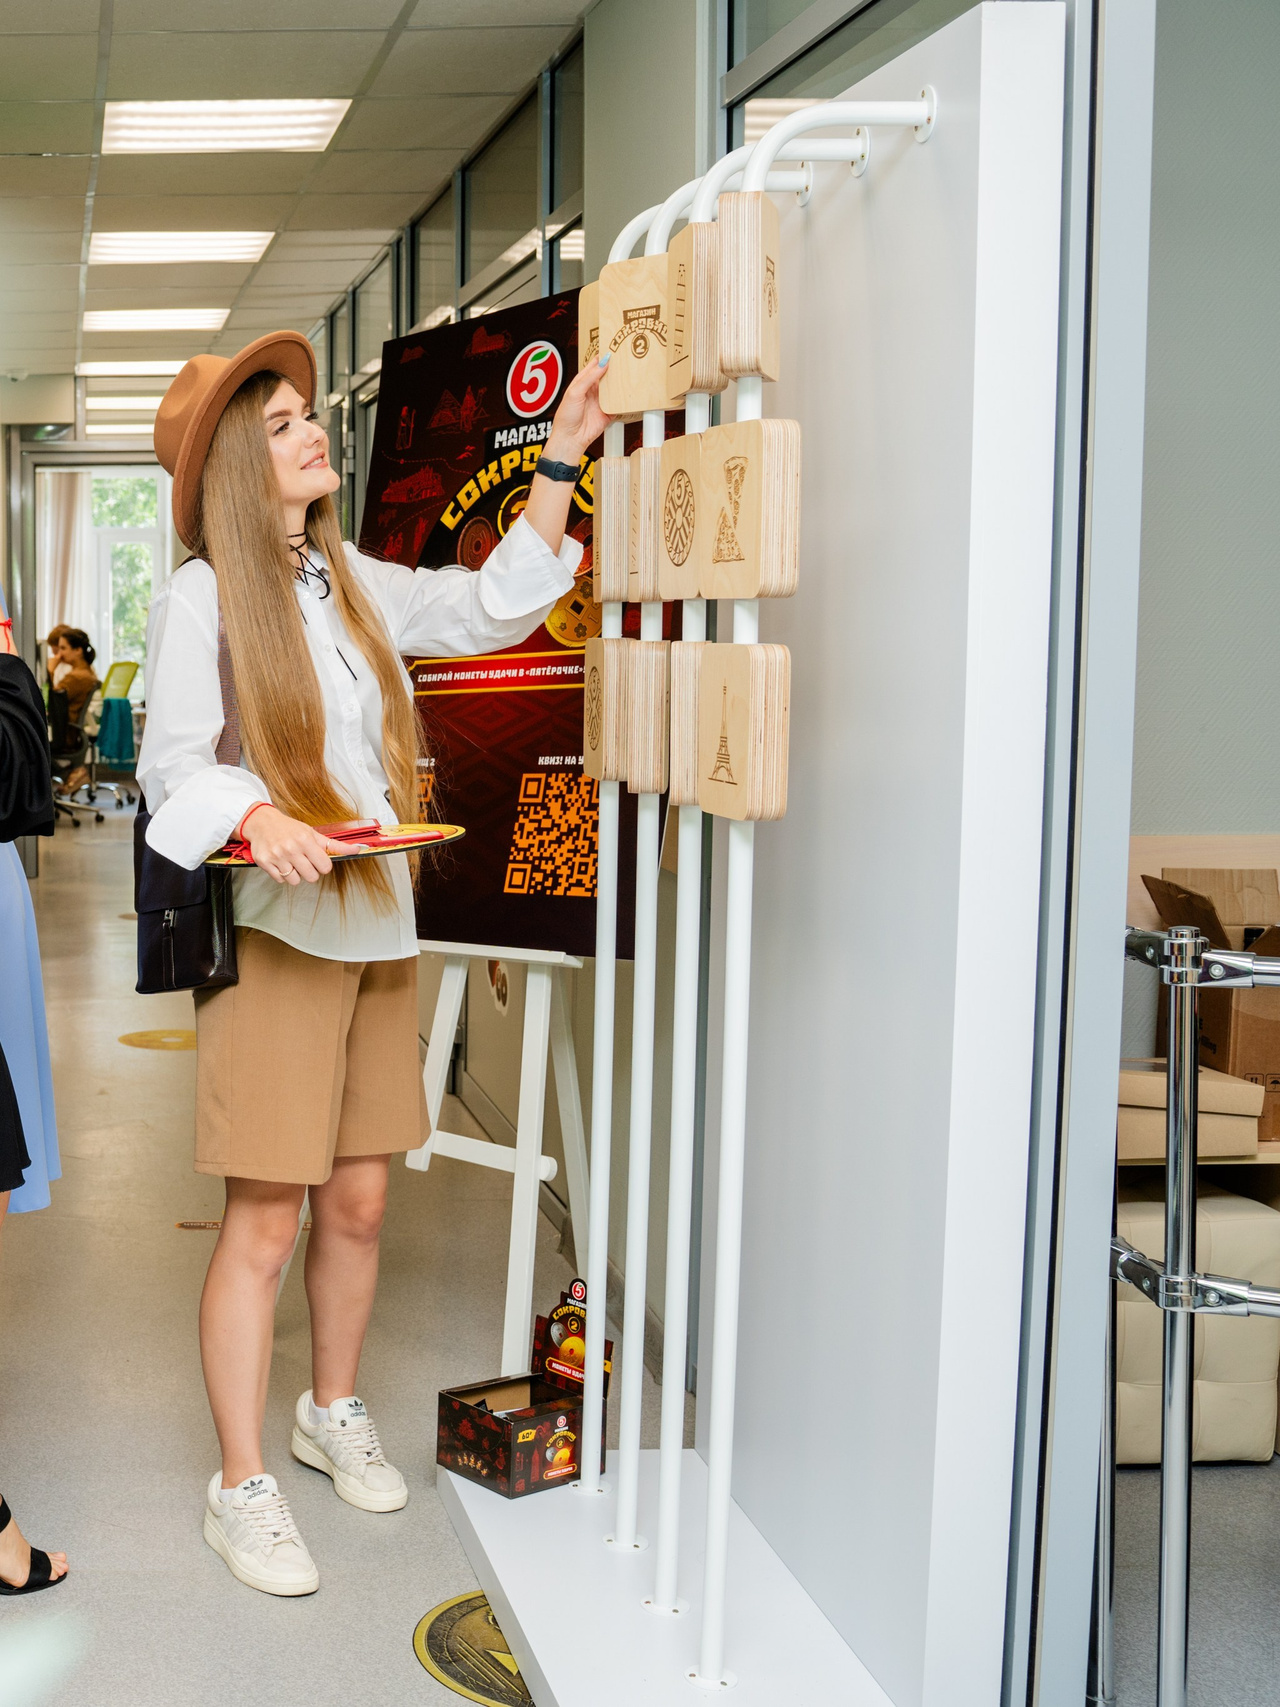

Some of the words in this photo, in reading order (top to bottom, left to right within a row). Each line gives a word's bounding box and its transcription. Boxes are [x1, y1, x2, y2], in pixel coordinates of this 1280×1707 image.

[627, 308, 657, 319] МАГАЗИН
[635, 339, 646, 353] 2
[520, 347, 551, 403] 5
[418, 671, 453, 682] СОБИРАЙ
[453, 670, 487, 680] МОНЕТЫ
[488, 668, 517, 679] УДАЧИ
[518, 668, 525, 677] В
[430, 758, 436, 767] 2
[538, 756, 563, 765] КВИЗ!
[564, 756, 577, 765] НА
[578, 756, 585, 765] У
[552, 1305, 586, 1321] СОКРОВ
[571, 1320, 578, 1331] 2
[247, 1489, 268, 1500] adidas
